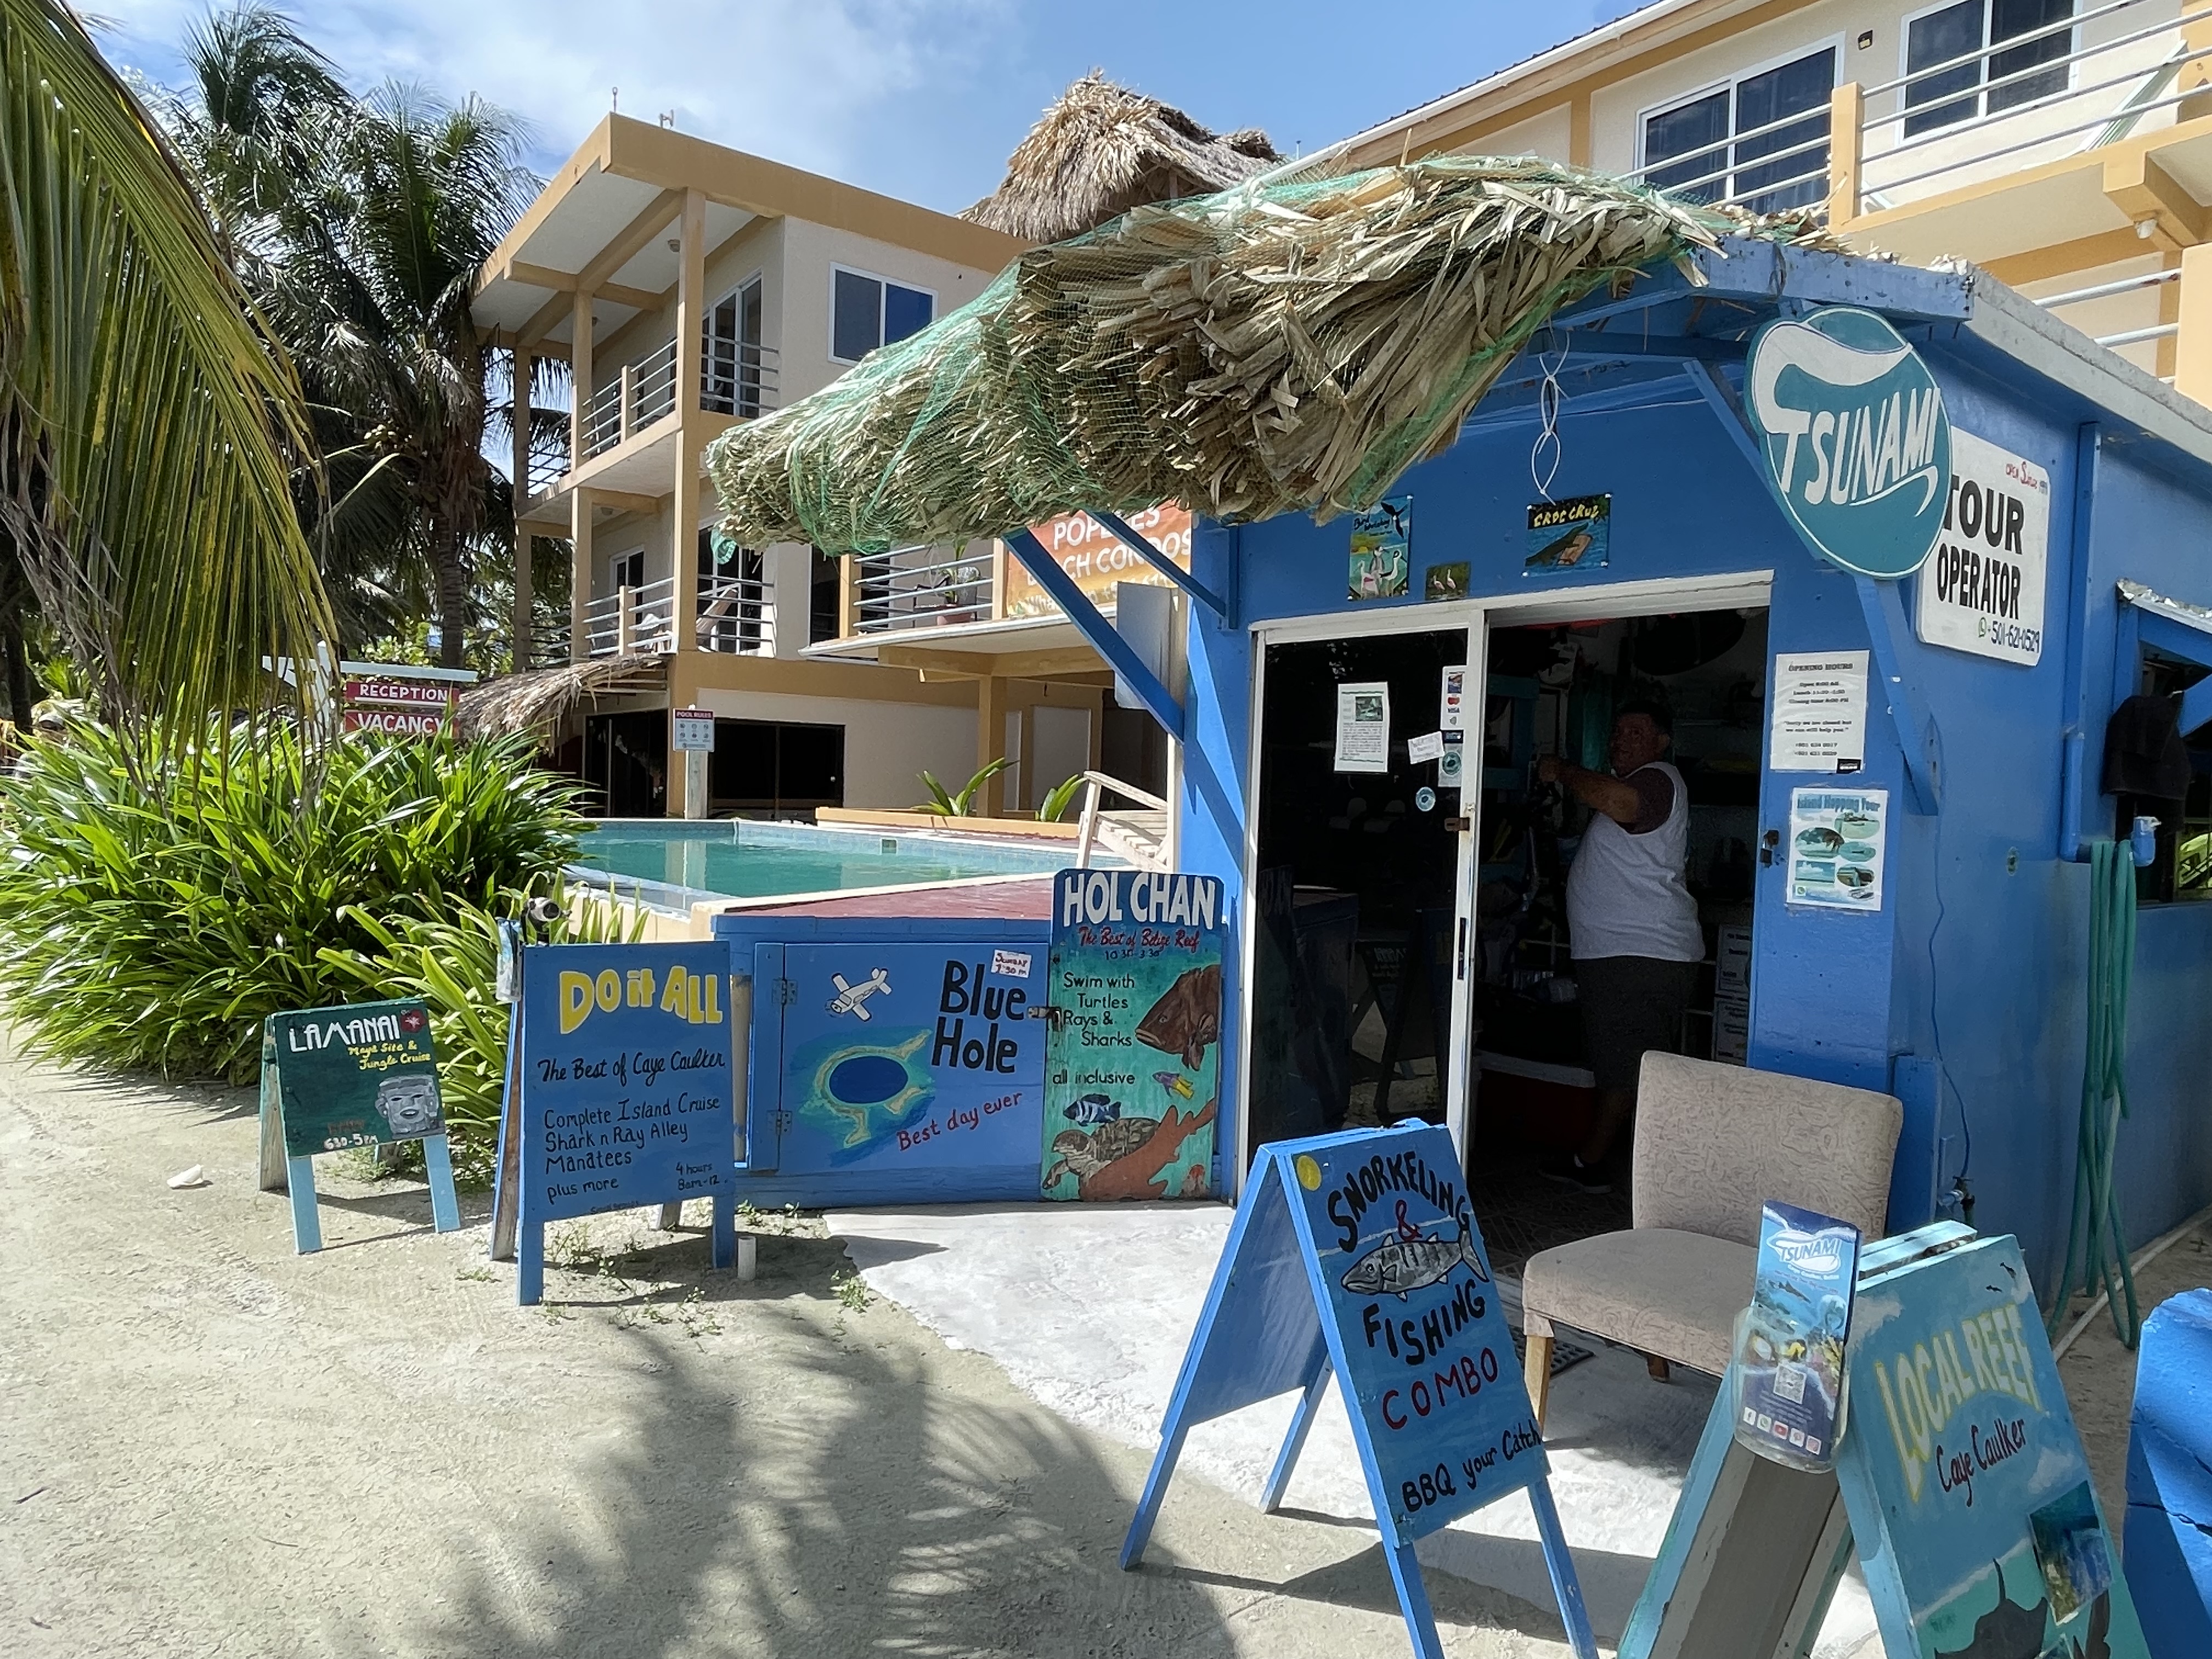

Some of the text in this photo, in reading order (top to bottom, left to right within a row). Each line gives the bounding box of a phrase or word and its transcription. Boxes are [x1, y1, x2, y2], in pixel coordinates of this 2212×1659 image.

[1758, 383, 1942, 507] TSUNAMI
[1943, 474, 2024, 555] TOUR
[1937, 543, 2021, 620] OPERATOR
[360, 684, 448, 701] RECEPTION
[358, 713, 445, 733] VACANCY
[1063, 871, 1216, 930] HOL CHAN
[1079, 925, 1200, 953] The Best of Belize Reef
[559, 968, 622, 1035] DO
[660, 964, 723, 1025] ALL
[939, 960, 1027, 1021] Blue
[1063, 971, 1135, 988] Swim with
[1063, 1009, 1114, 1031] Rays &
[1076, 993, 1129, 1009] Turtles
[289, 1014, 401, 1052] LAMANAI
[348, 1040, 417, 1058] Maya Site &
[931, 1015, 1019, 1074] Hole
[1081, 1031, 1133, 1047] Sharks
[359, 1051, 431, 1071] Jungle Cruise
[538, 1047, 726, 1087] The Best of Caye Caulker
[1052, 1068, 1136, 1085] all inclusive
[544, 1091, 721, 1136] Complete Island Cruise
[896, 1091, 1023, 1152] Best day ever
[544, 1120, 689, 1153] Shark n Ray Alley
[545, 1150, 633, 1175] Manatees
[676, 1161, 713, 1175] 4 hours
[548, 1177, 619, 1206] plus more
[1327, 1150, 1471, 1253] SNORKELING
[1395, 1199, 1422, 1243] &
[1780, 1238, 1841, 1262] TSUNAMI
[1362, 1279, 1486, 1367] FISHING
[1382, 1347, 1499, 1430] COMBO
[1875, 1302, 2045, 1504] LOCAL REEF
[1402, 1419, 1543, 1514] BBQ your Catch
[1936, 1418, 2027, 1509] Caye Caulker
